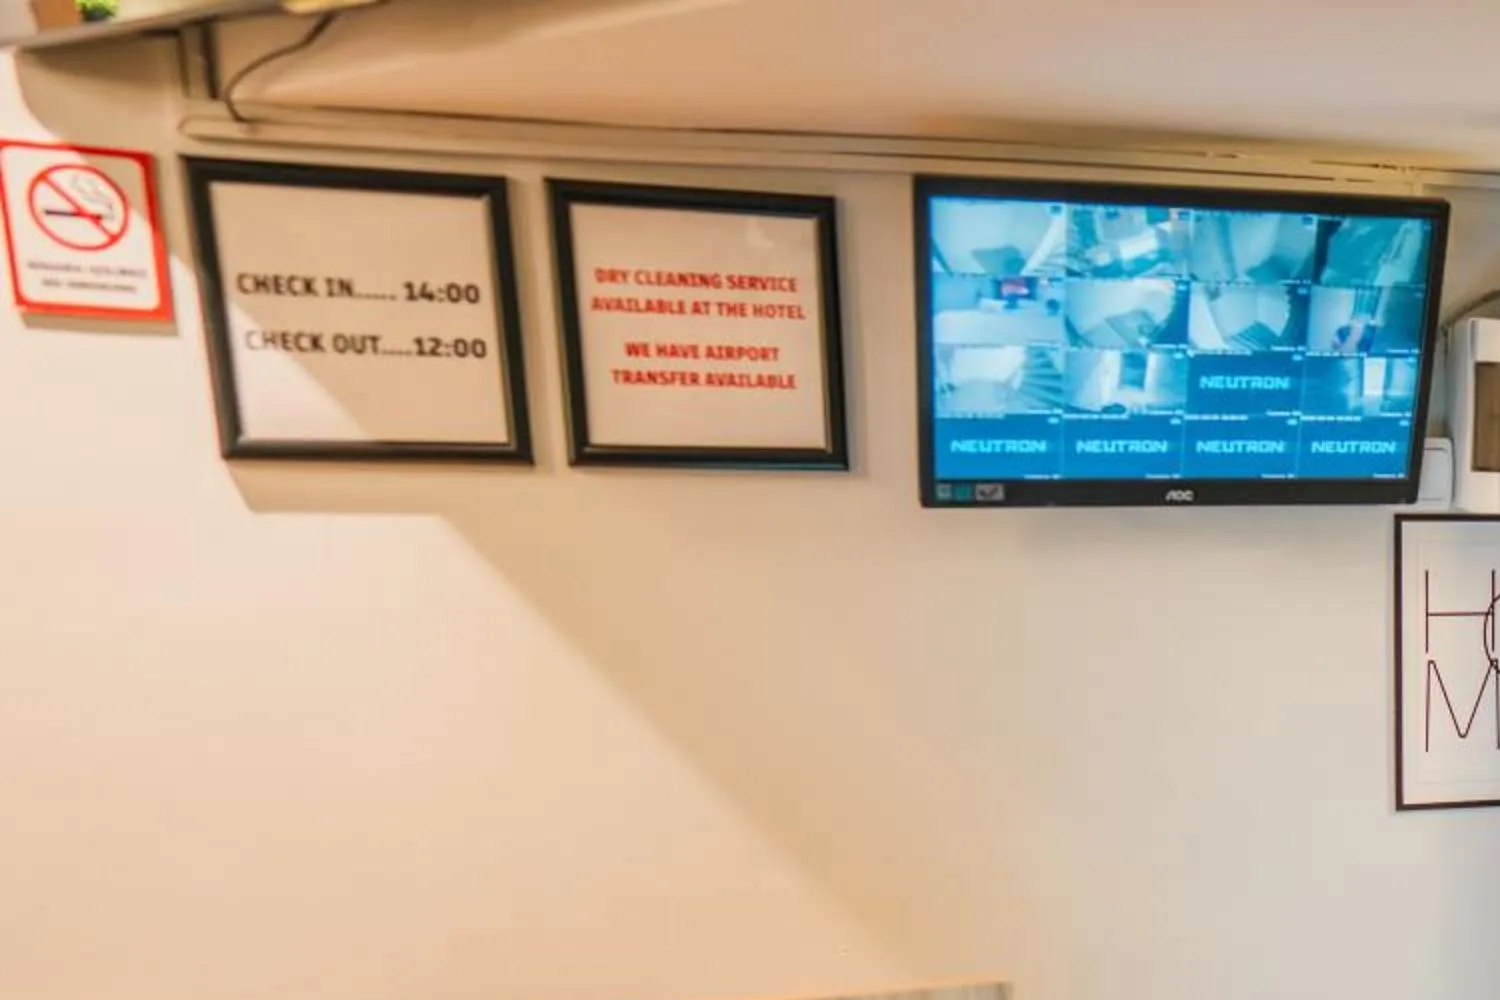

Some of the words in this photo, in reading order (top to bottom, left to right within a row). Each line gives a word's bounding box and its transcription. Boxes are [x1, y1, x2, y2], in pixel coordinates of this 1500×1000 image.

[594, 268, 629, 284] DRY
[634, 270, 722, 289] CLEANING
[726, 274, 797, 292] SERVICE
[236, 273, 318, 296] CHECK
[403, 282, 480, 304] 14:00
[591, 296, 685, 315] AVAILABLE
[691, 300, 710, 316] AT
[717, 302, 747, 318] THE
[752, 304, 806, 320] HOTEL
[245, 330, 325, 353] CHECK
[413, 337, 487, 358] 12:00
[625, 343, 651, 358] WE
[656, 343, 699, 359] HAVE
[705, 345, 779, 361] AIRPORT
[611, 369, 699, 386] TRANSFER
[705, 373, 796, 389] AVAILABLE
[1200, 376, 1290, 390] NEUTRON
[950, 438, 1047, 453] NEUTRON
[1076, 439, 1168, 454] NEUTRON
[1197, 440, 1286, 453] NEUTRON
[1311, 441, 1396, 454] NEUTRON
[1165, 490, 1194, 501] AOC
